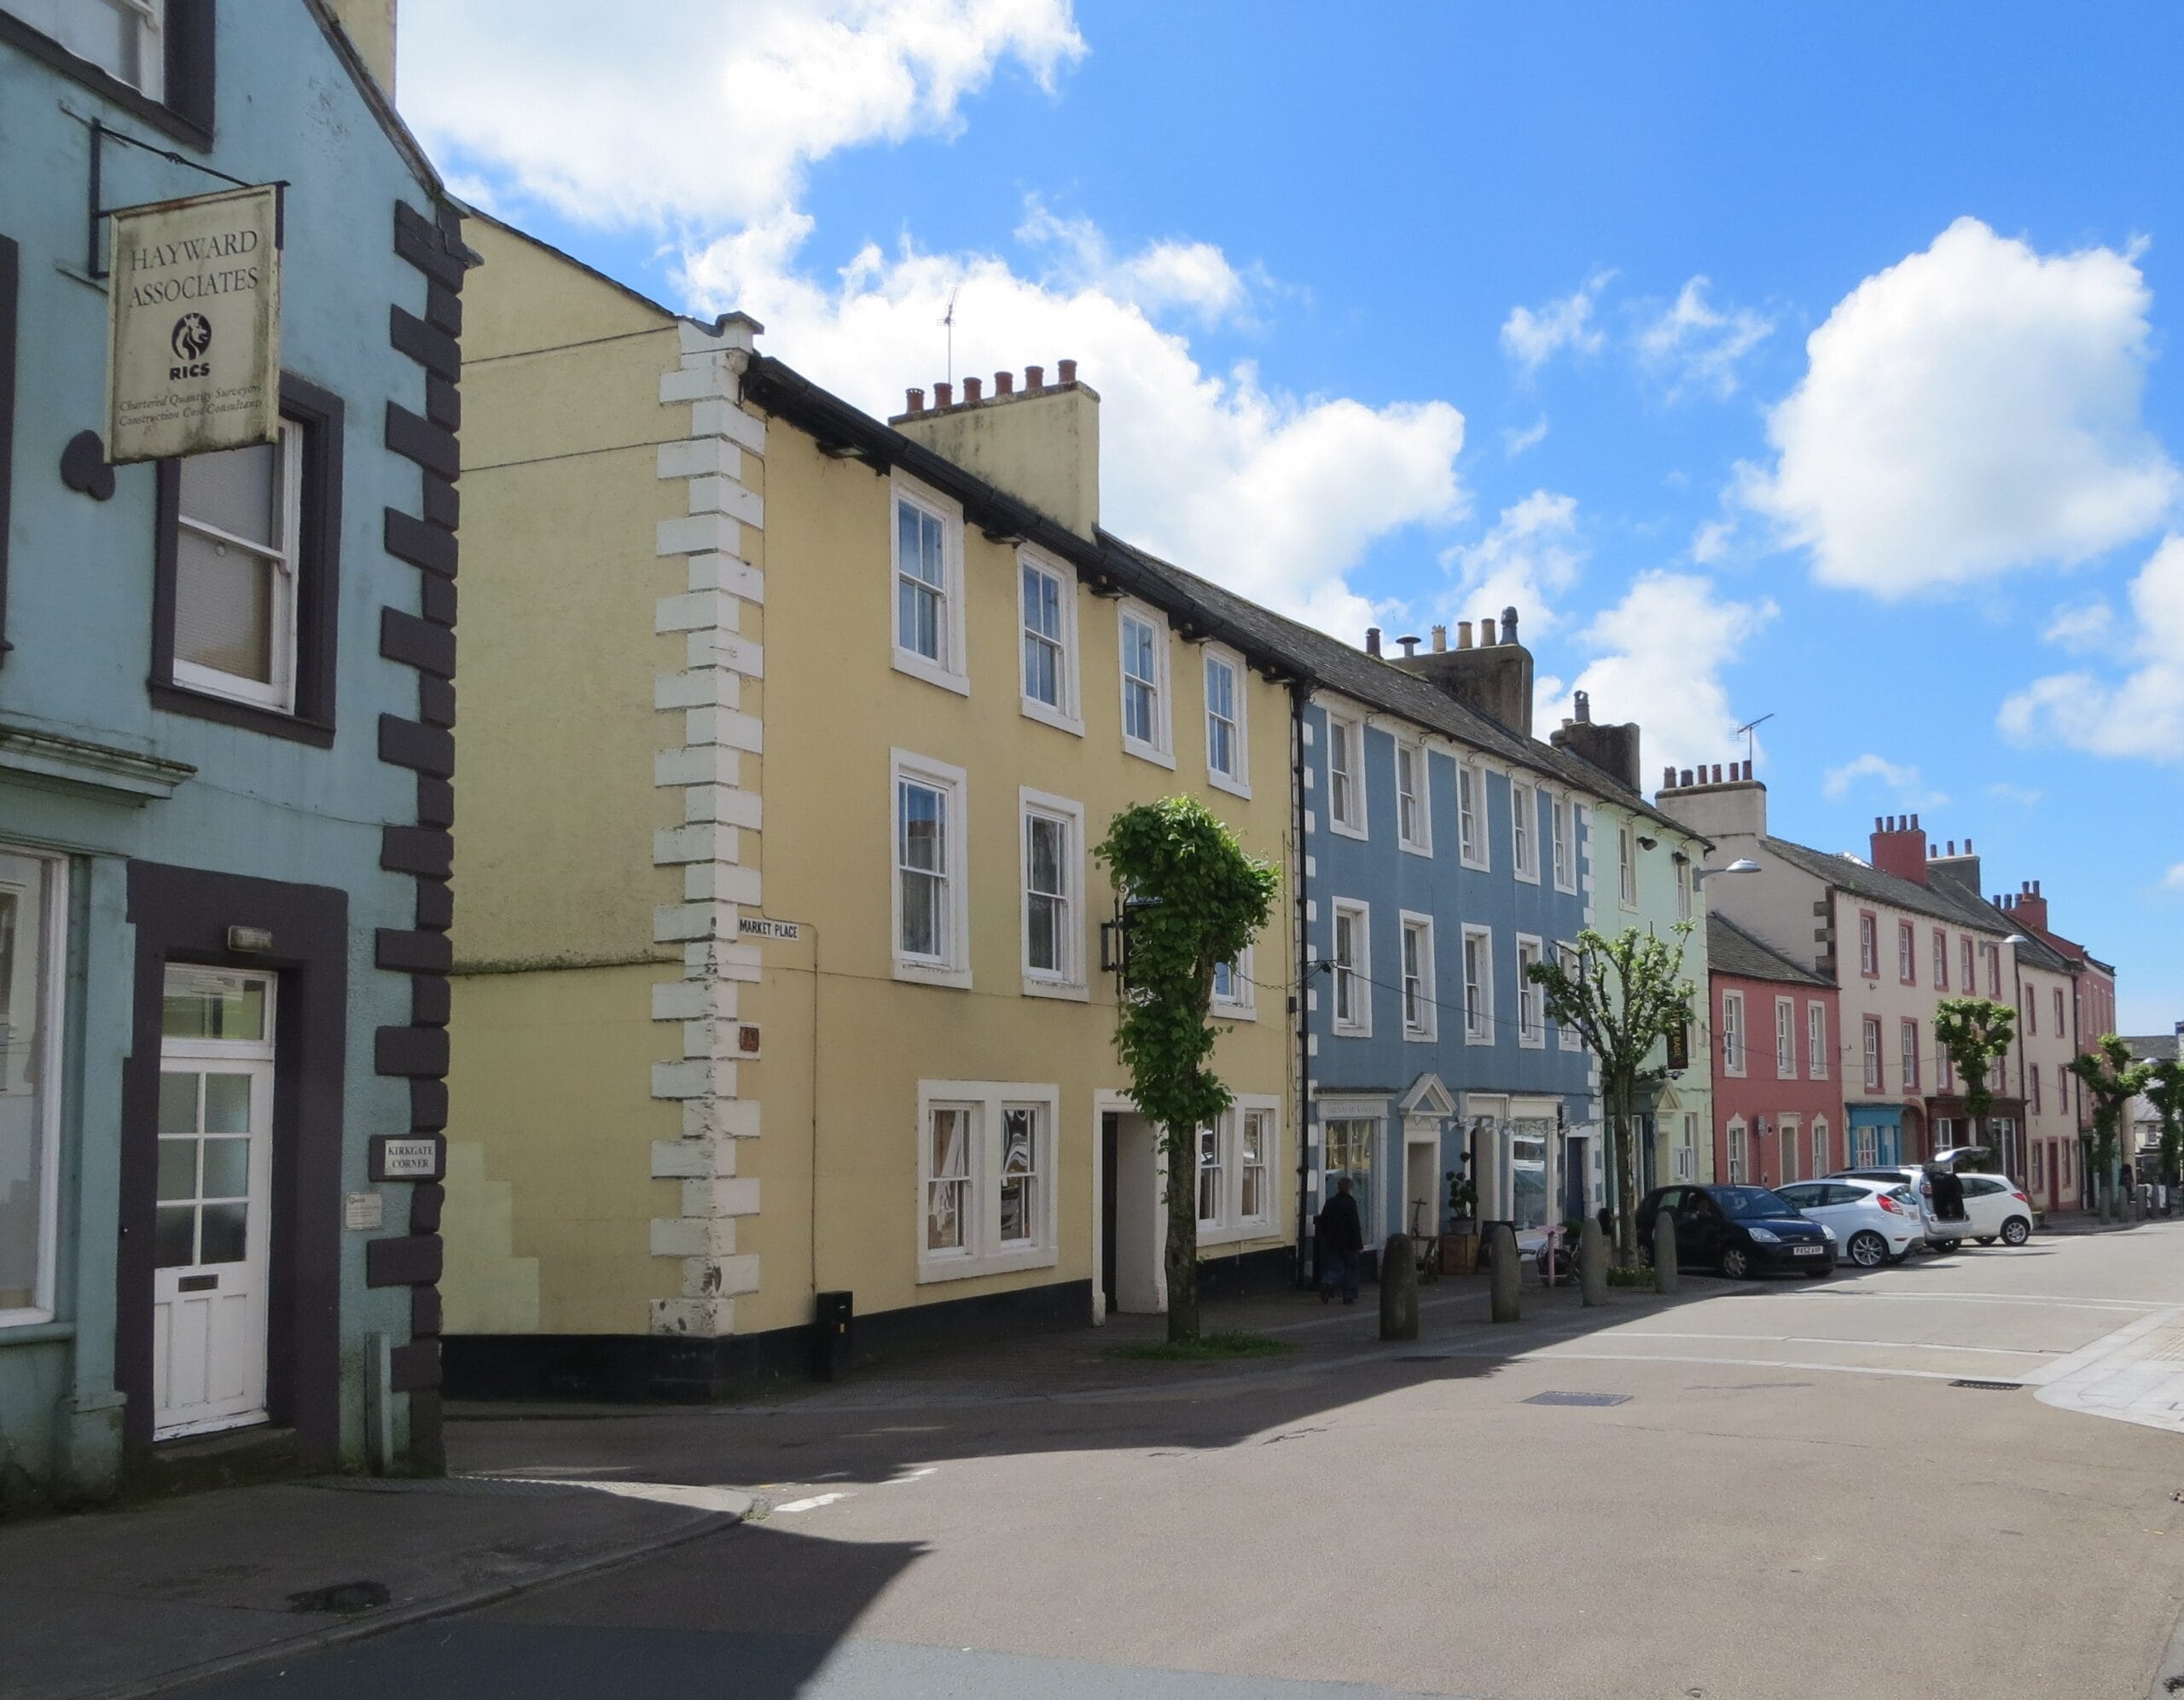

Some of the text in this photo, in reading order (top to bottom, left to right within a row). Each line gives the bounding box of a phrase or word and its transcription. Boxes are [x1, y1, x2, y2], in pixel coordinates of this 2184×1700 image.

[131, 230, 258, 271] HAYWARD
[127, 267, 258, 308] ASSOCIATES
[170, 362, 211, 380] RICS
[119, 396, 168, 411] Chartered
[170, 392, 212, 406] Quantity
[119, 411, 179, 426] Construction
[739, 919, 798, 938] MARKET PLACE
[388, 1146, 433, 1155] KIRKGATE
[392, 1159, 428, 1168] CORNER
